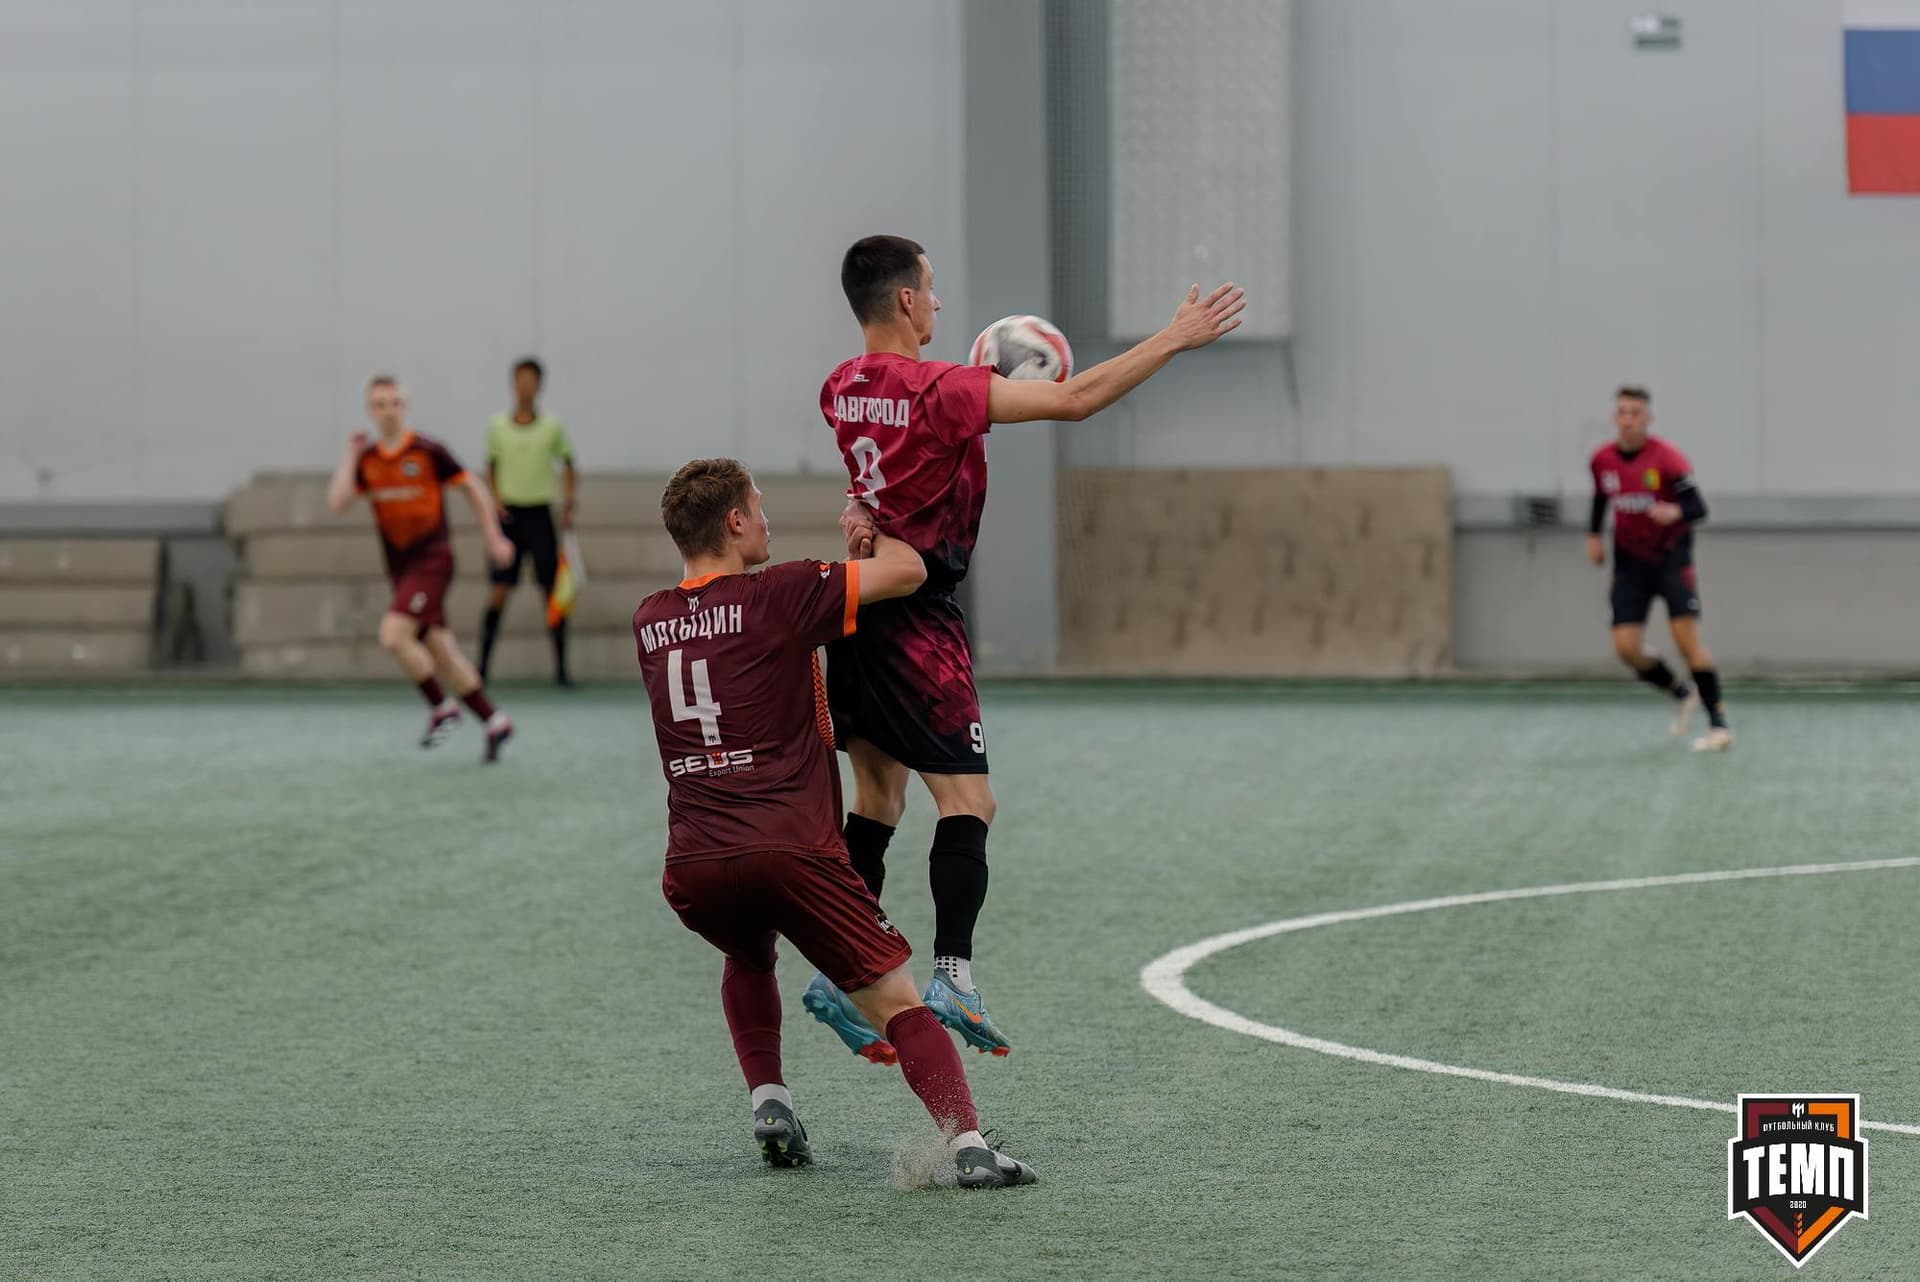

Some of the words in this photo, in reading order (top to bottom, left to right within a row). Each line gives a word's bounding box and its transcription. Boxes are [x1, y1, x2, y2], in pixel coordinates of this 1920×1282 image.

[640, 604, 742, 654] МАТЫЦИН
[667, 648, 722, 747] 4
[969, 721, 985, 754] 9
[669, 749, 753, 778] SEUS
[709, 767, 733, 777] Export
[734, 764, 755, 773] Union
